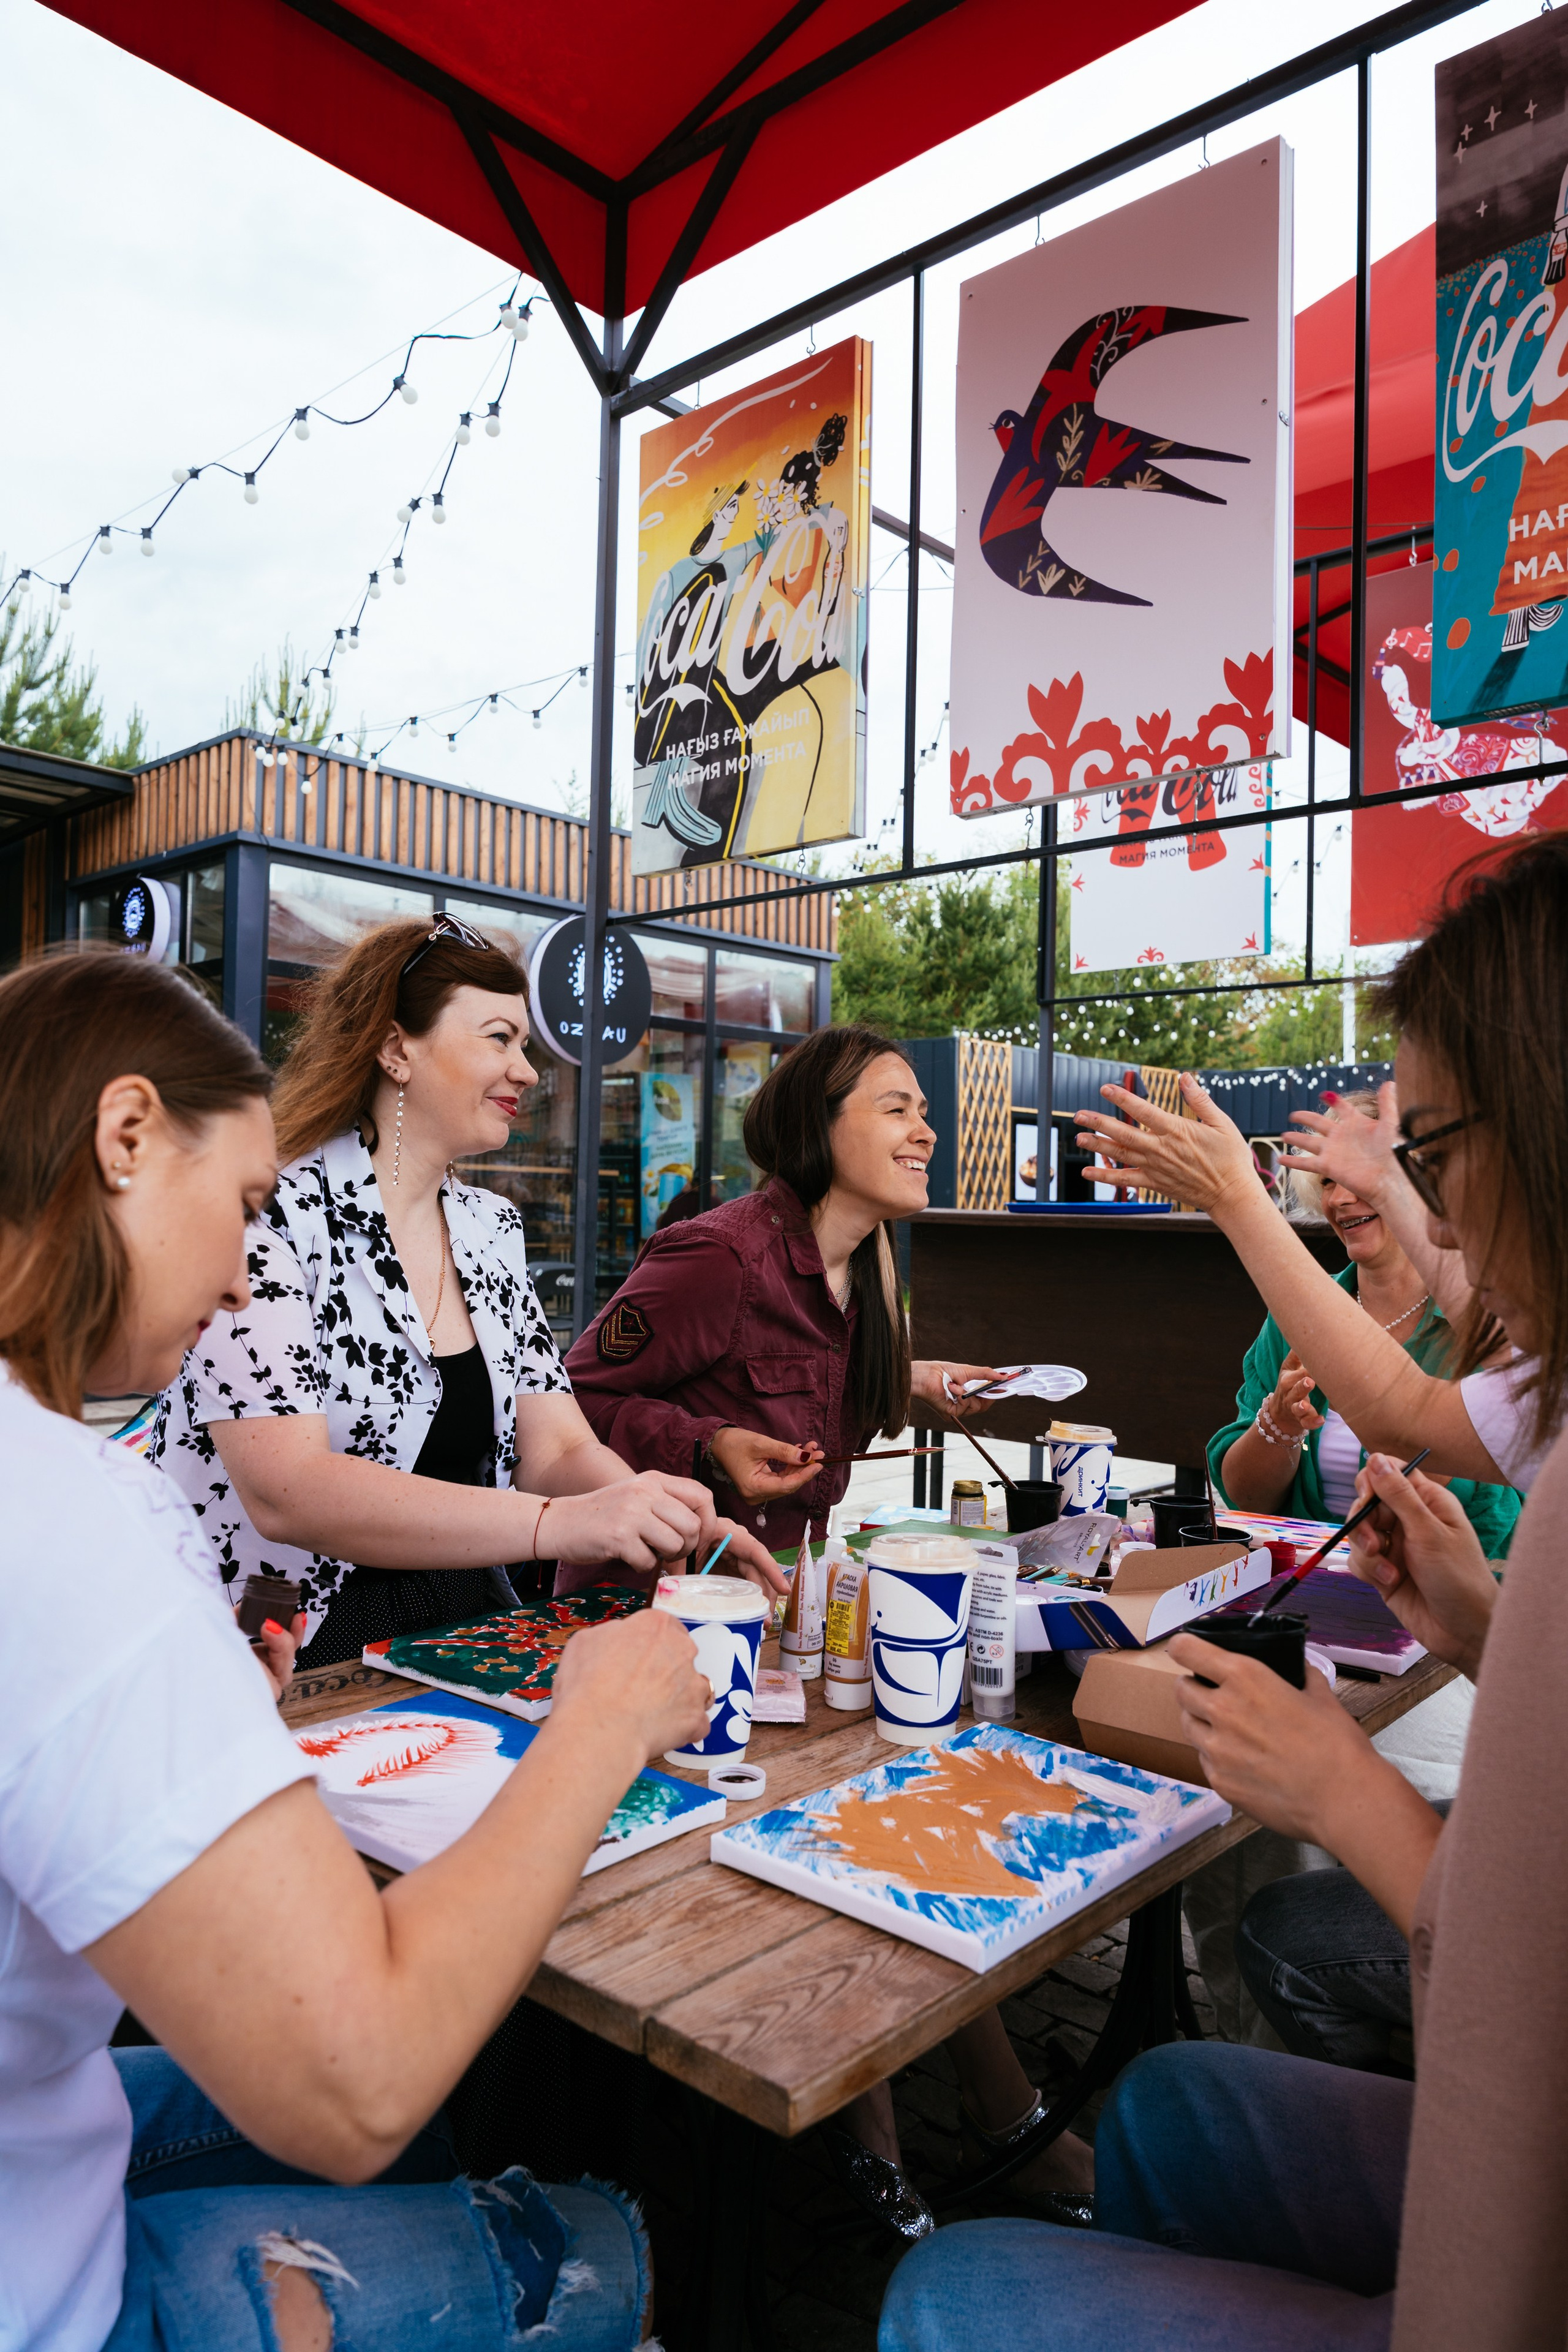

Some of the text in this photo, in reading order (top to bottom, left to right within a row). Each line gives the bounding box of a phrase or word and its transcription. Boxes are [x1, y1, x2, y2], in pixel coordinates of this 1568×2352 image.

[1513, 548, 1568, 585] МА
[666, 707, 809, 761] НАҒЫЗ ҒАЖАЙЫП
[668, 741, 807, 790] МАГИЯ МОМЕНТА
[1119, 842, 1215, 864] МАГИЯ МОМЕНТА
